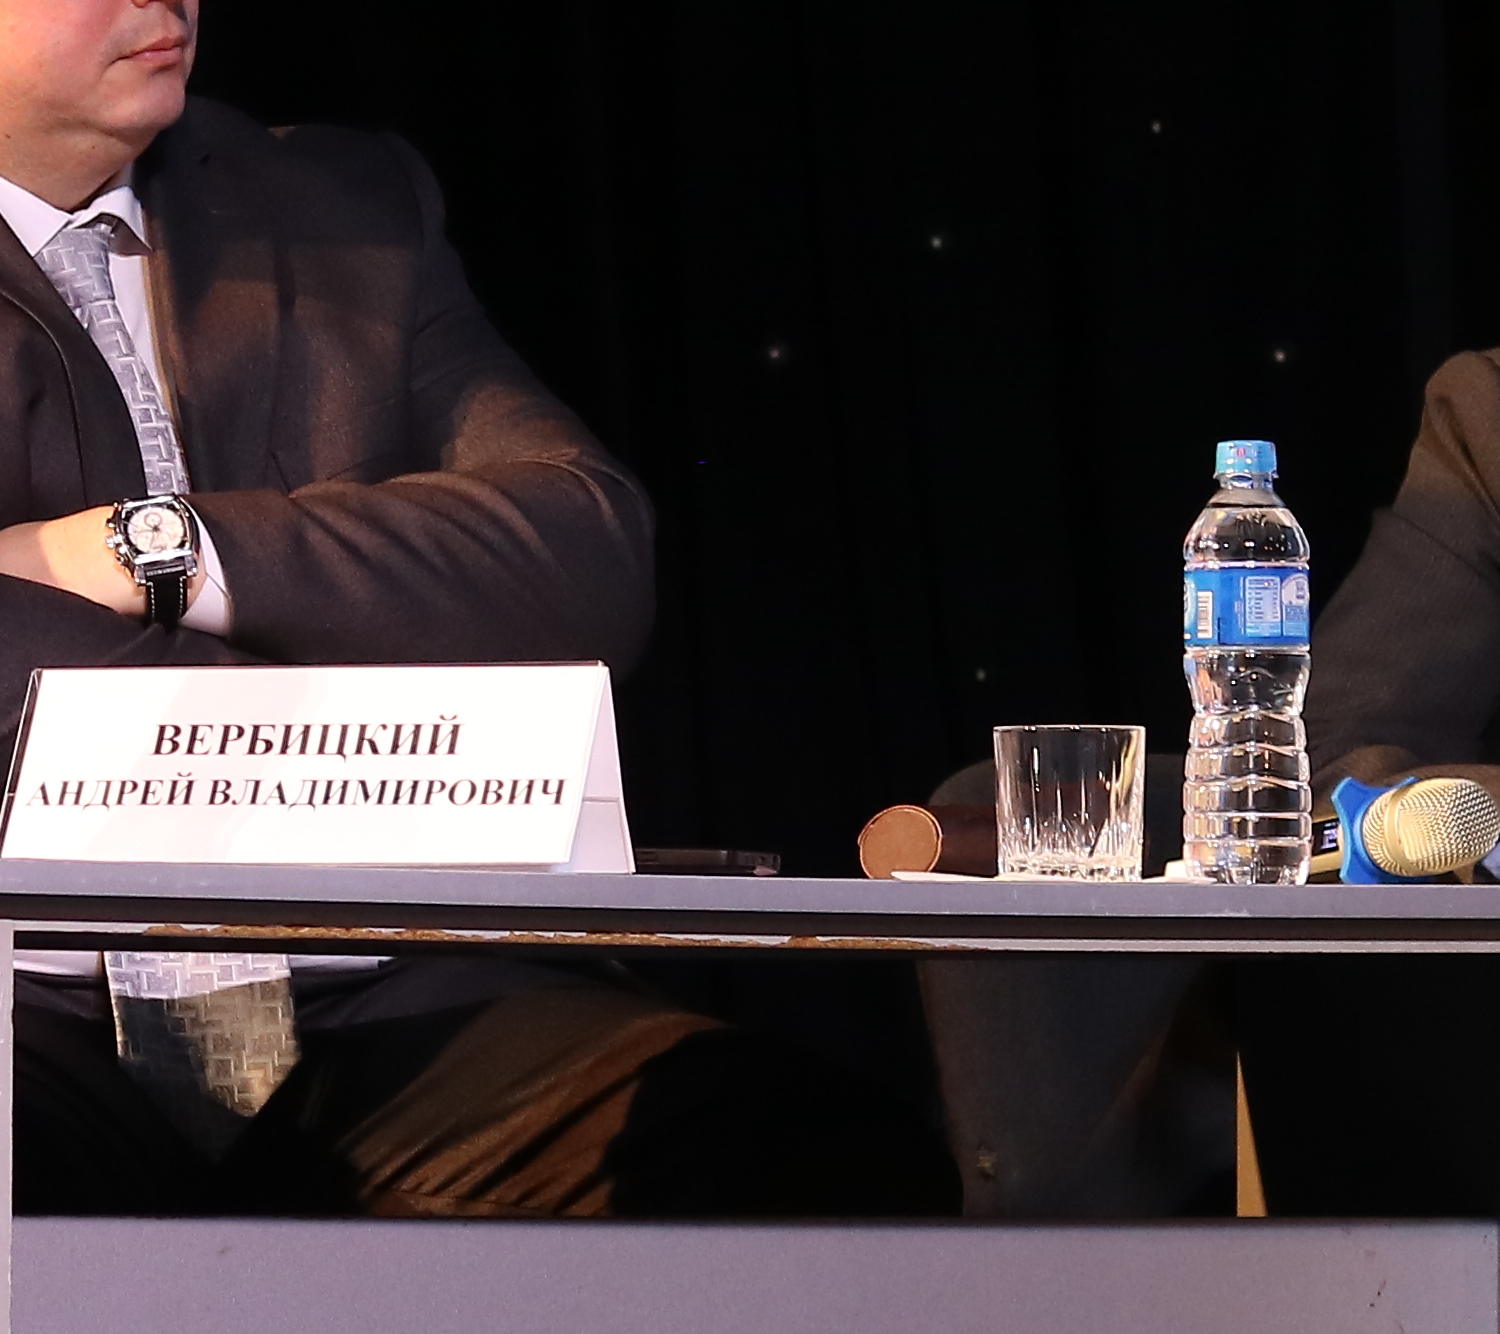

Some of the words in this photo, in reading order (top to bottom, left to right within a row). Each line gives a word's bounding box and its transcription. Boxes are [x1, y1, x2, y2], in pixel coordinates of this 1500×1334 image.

[150, 714, 463, 761] ВЕРБИЦКИЙ
[26, 771, 196, 811] АНДРЕЙ
[206, 777, 566, 811] ВЛАДИМИРОВИЧ
